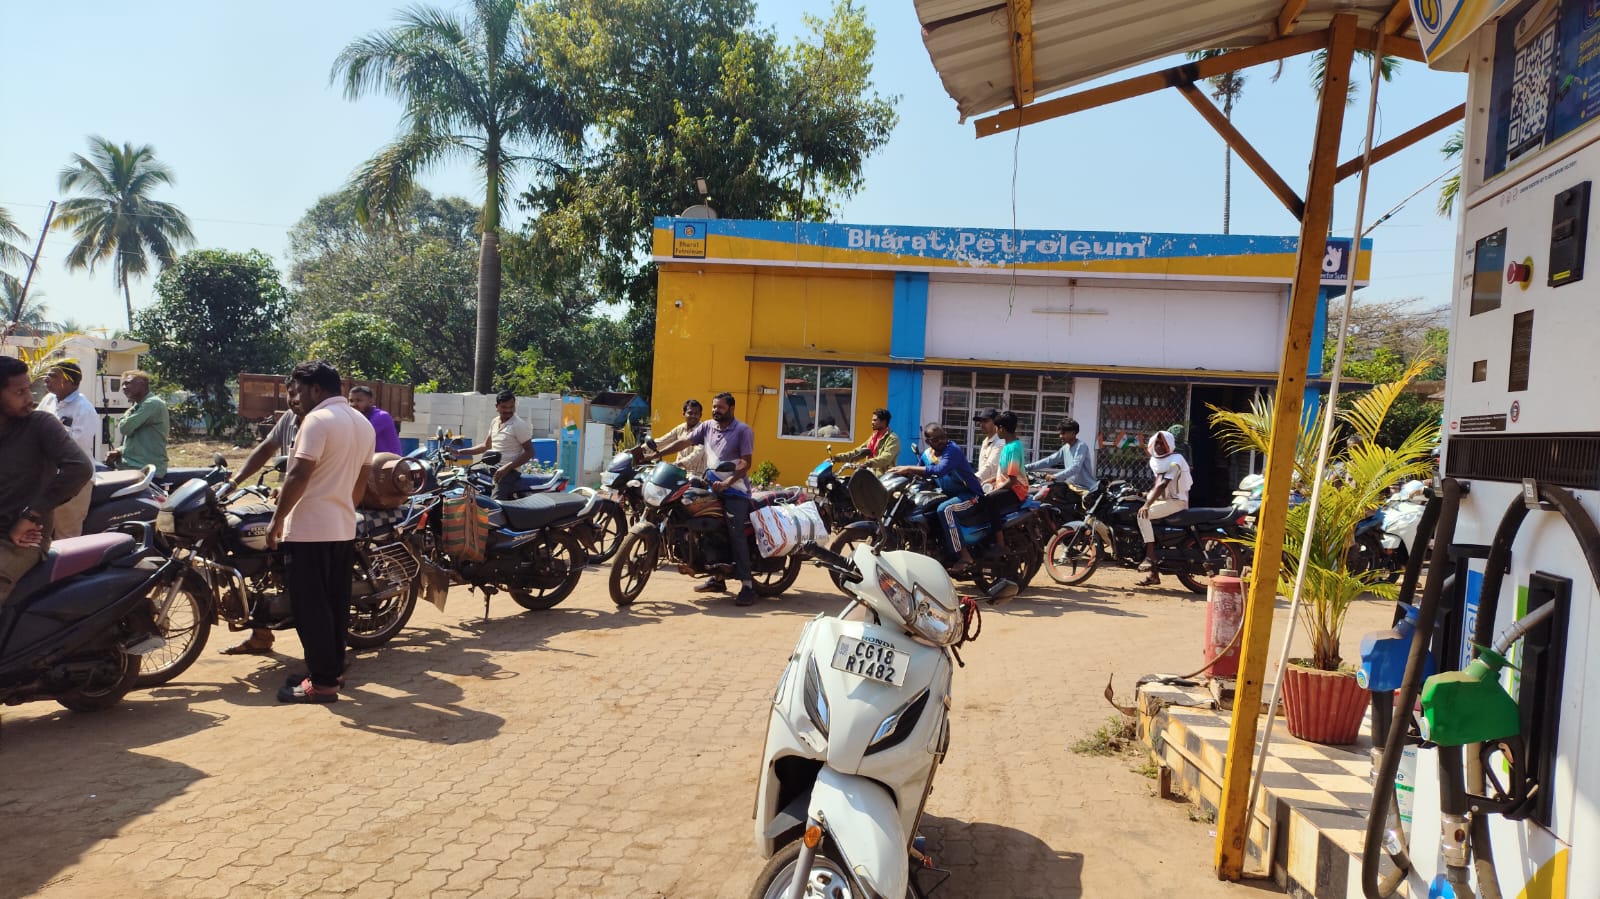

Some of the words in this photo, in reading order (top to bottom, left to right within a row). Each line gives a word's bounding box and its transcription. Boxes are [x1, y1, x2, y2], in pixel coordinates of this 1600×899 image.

[848, 228, 944, 251] Bharat
[959, 232, 1147, 257] Petroleum
[855, 641, 894, 665] CG18
[861, 636, 895, 649] HONDA
[845, 655, 895, 682] R1482
